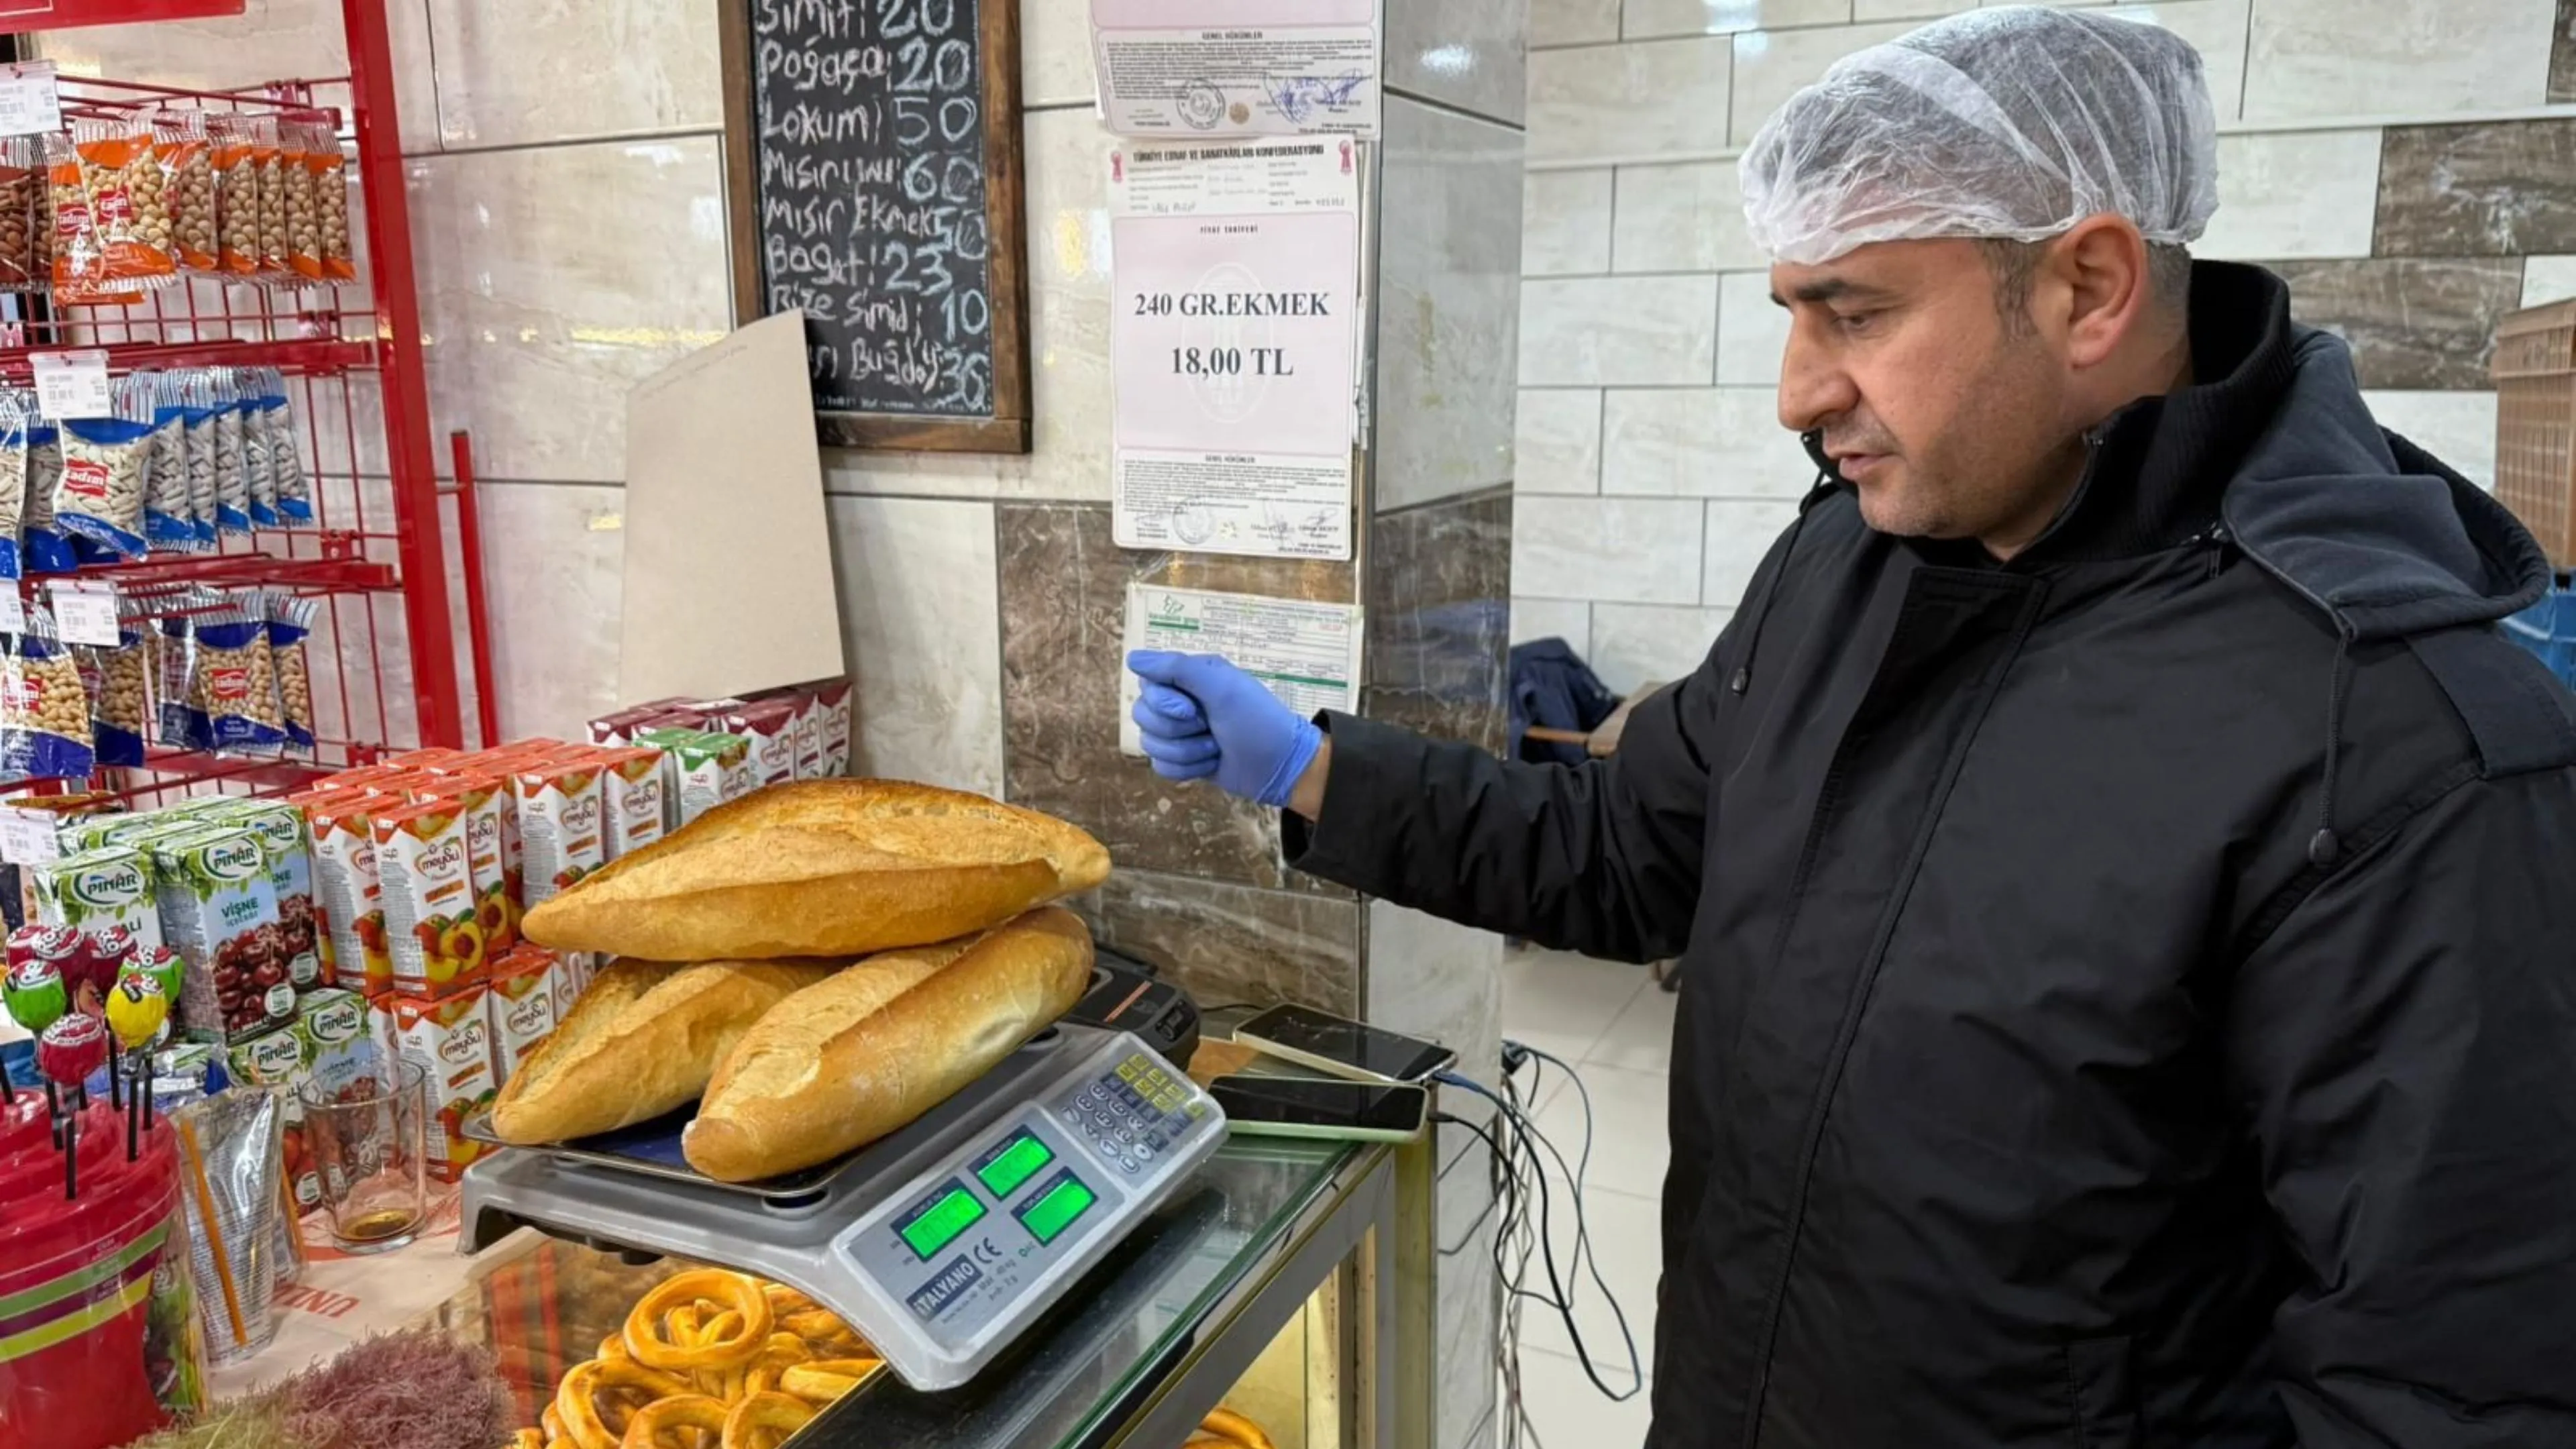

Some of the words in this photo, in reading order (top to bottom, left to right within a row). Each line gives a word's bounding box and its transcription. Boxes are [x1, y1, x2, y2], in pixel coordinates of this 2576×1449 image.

[876, 0, 955, 39] 20
[894, 36, 971, 92] 20
[894, 96, 977, 145] 50
[903, 152, 979, 203] 60
[880, 240, 953, 296] 23
[940, 288, 987, 339] 10
[1134, 294, 1172, 315] 240
[1180, 292, 1330, 315] GR.EKMEK
[1173, 347, 1241, 380] 18,00
[1250, 347, 1294, 376] TL
